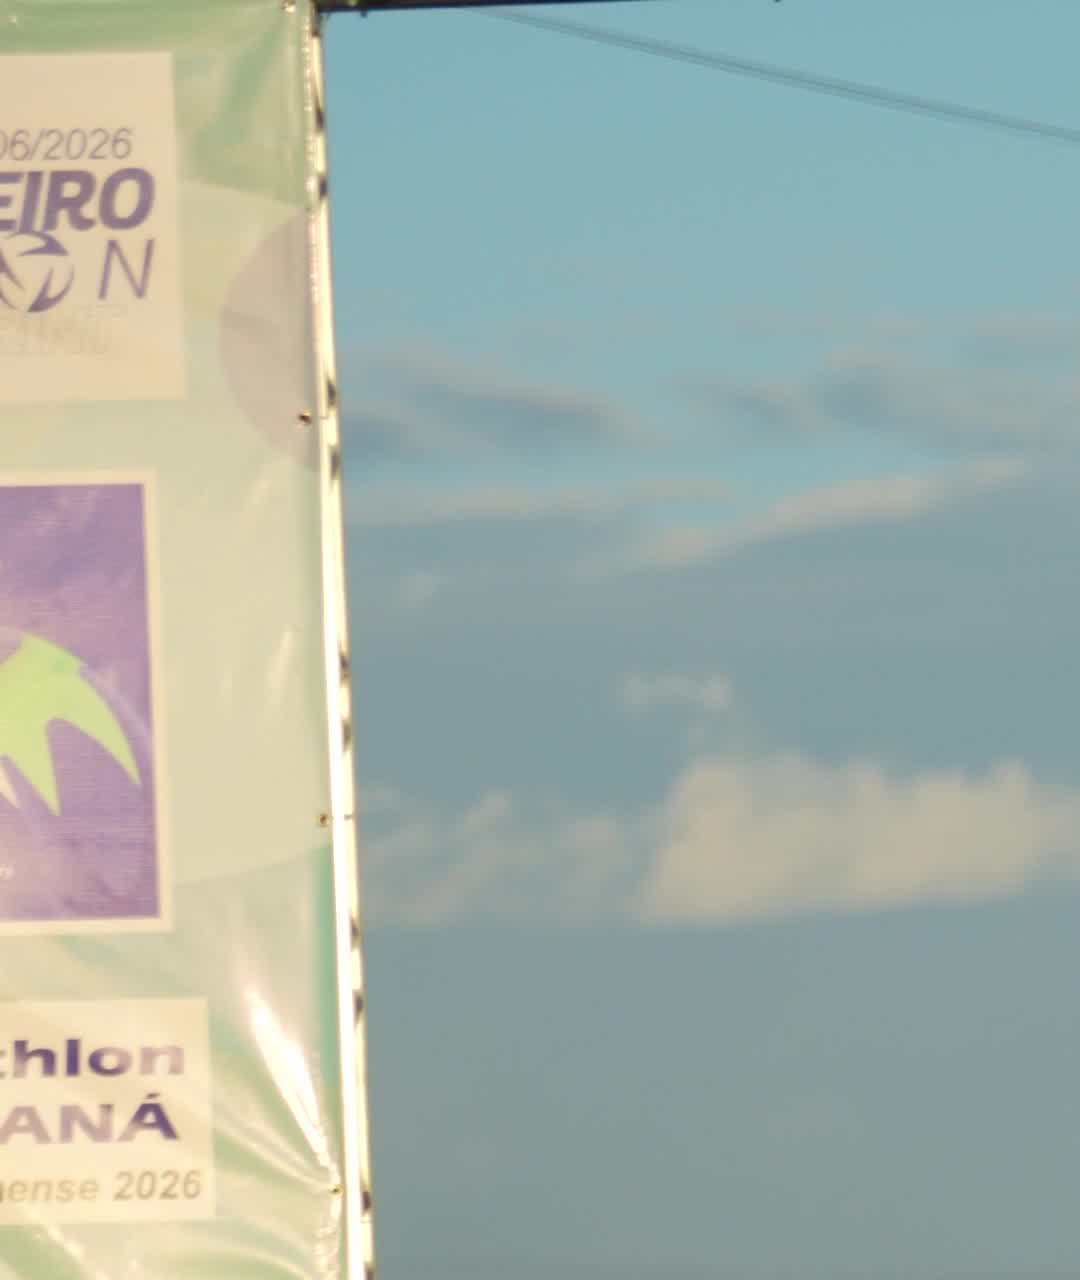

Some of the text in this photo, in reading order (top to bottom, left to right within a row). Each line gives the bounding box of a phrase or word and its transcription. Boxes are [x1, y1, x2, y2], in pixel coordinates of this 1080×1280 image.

[0, 1039, 185, 1078] hlon
[0, 1092, 180, 1144] ANÁ
[0, 1169, 202, 1203] ense 2026
